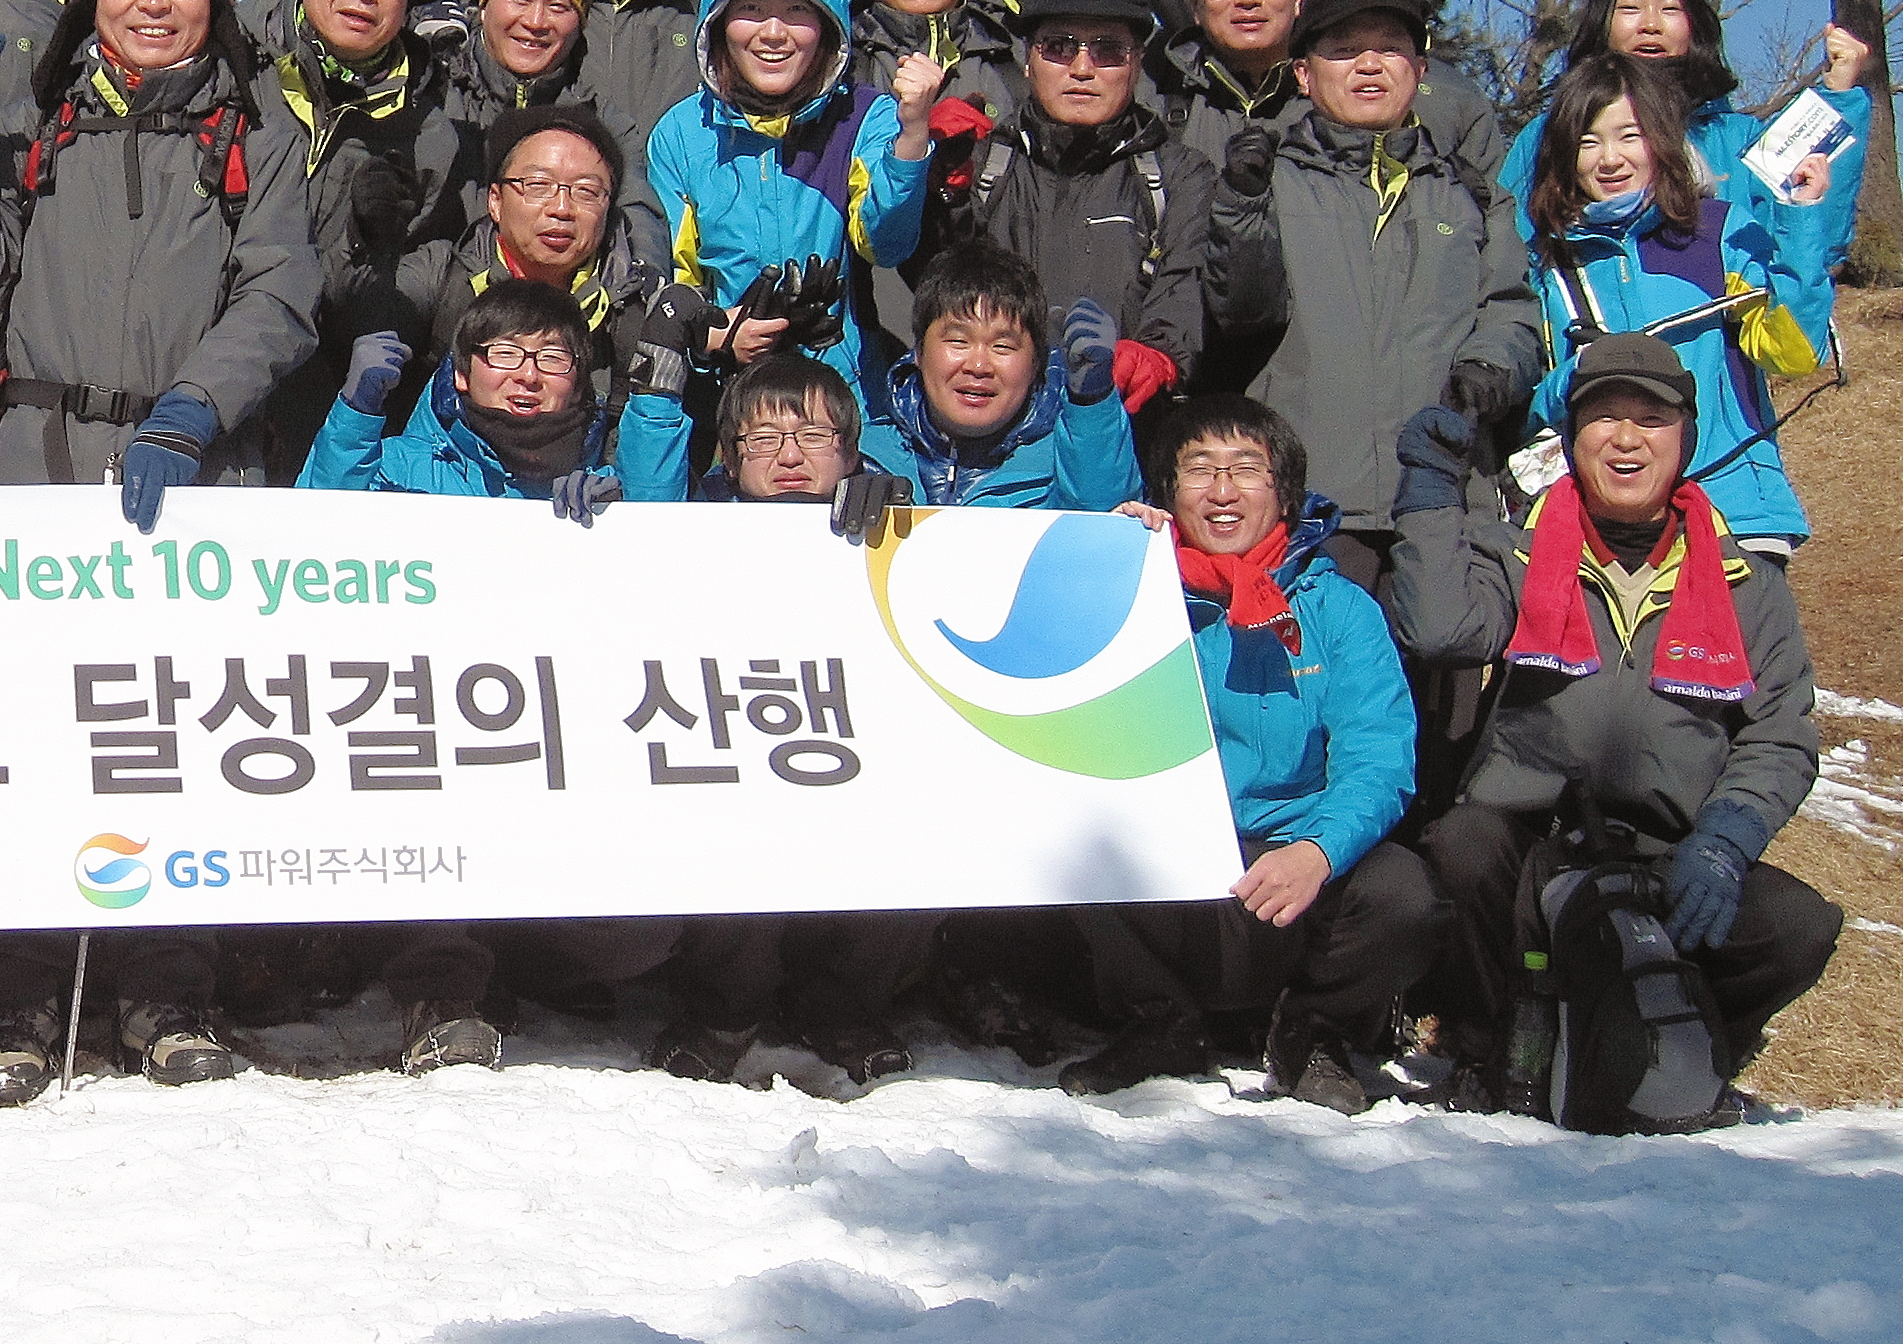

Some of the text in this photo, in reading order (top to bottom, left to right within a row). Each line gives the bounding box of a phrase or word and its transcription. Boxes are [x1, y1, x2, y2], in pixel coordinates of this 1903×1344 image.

[151, 538, 232, 601] 10
[251, 558, 437, 616] years
[1688, 646, 1705, 660] GS
[73, 654, 567, 796] 달성결의
[622, 656, 862, 787] 산행
[164, 845, 467, 889] GS 파워주식회사
